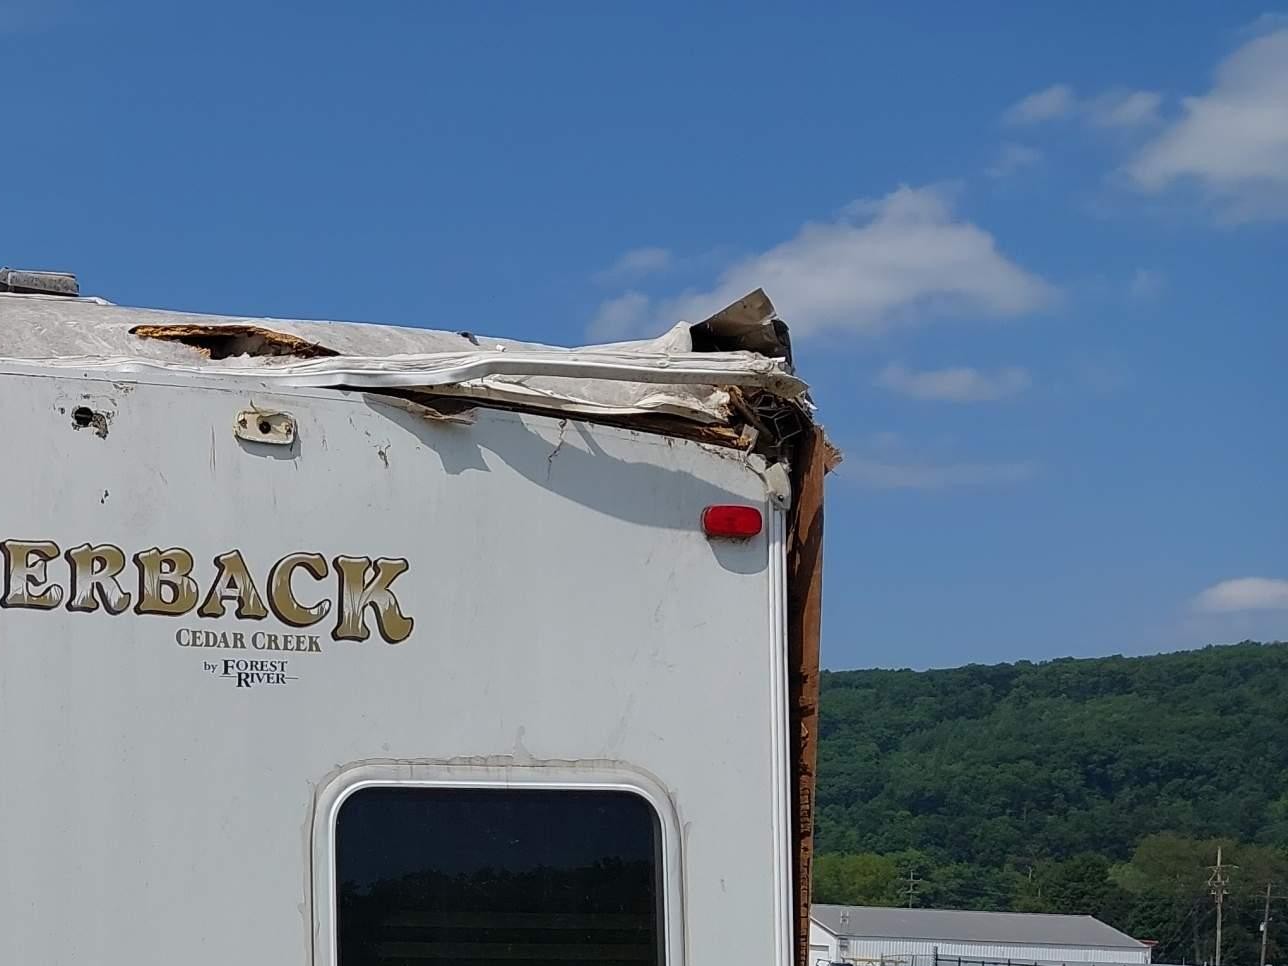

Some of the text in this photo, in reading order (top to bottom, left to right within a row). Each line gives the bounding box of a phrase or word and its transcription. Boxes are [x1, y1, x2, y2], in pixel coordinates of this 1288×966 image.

[175, 628, 322, 652] CEDAR CREEK
[203, 659, 288, 675] by FOREST
[236, 671, 287, 688] RIVER
